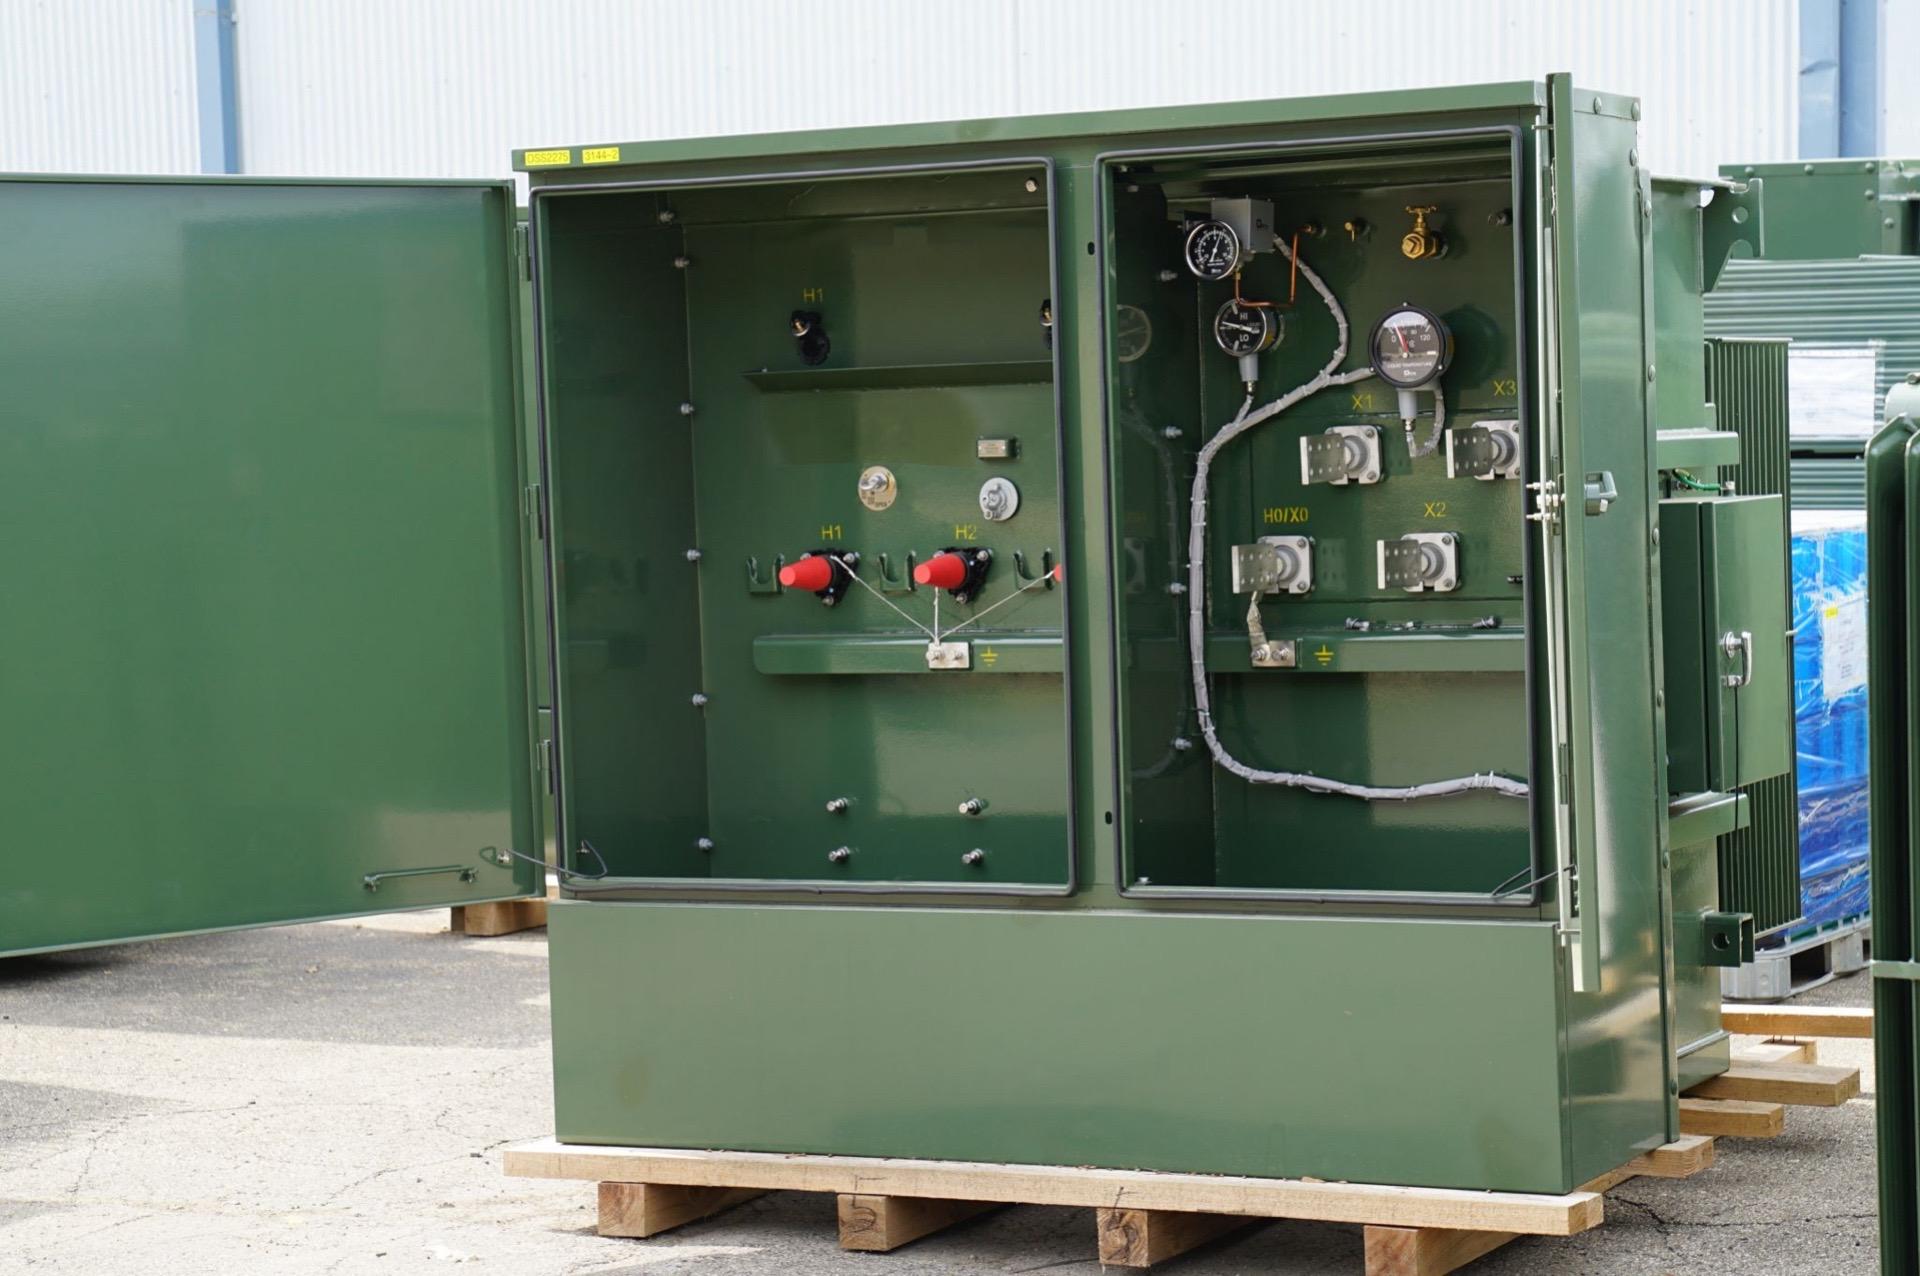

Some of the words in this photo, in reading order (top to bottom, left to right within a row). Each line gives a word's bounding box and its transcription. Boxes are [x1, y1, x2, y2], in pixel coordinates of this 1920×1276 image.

[585, 149, 617, 161] 3144-2
[803, 288, 823, 302] H1
[1240, 312, 1248, 320] HI
[1240, 334, 1249, 342] LO
[1494, 380, 1516, 396] X3
[1352, 394, 1373, 409] X1
[1424, 502, 1447, 518] X2
[821, 525, 842, 540] H1
[955, 524, 977, 540] H2
